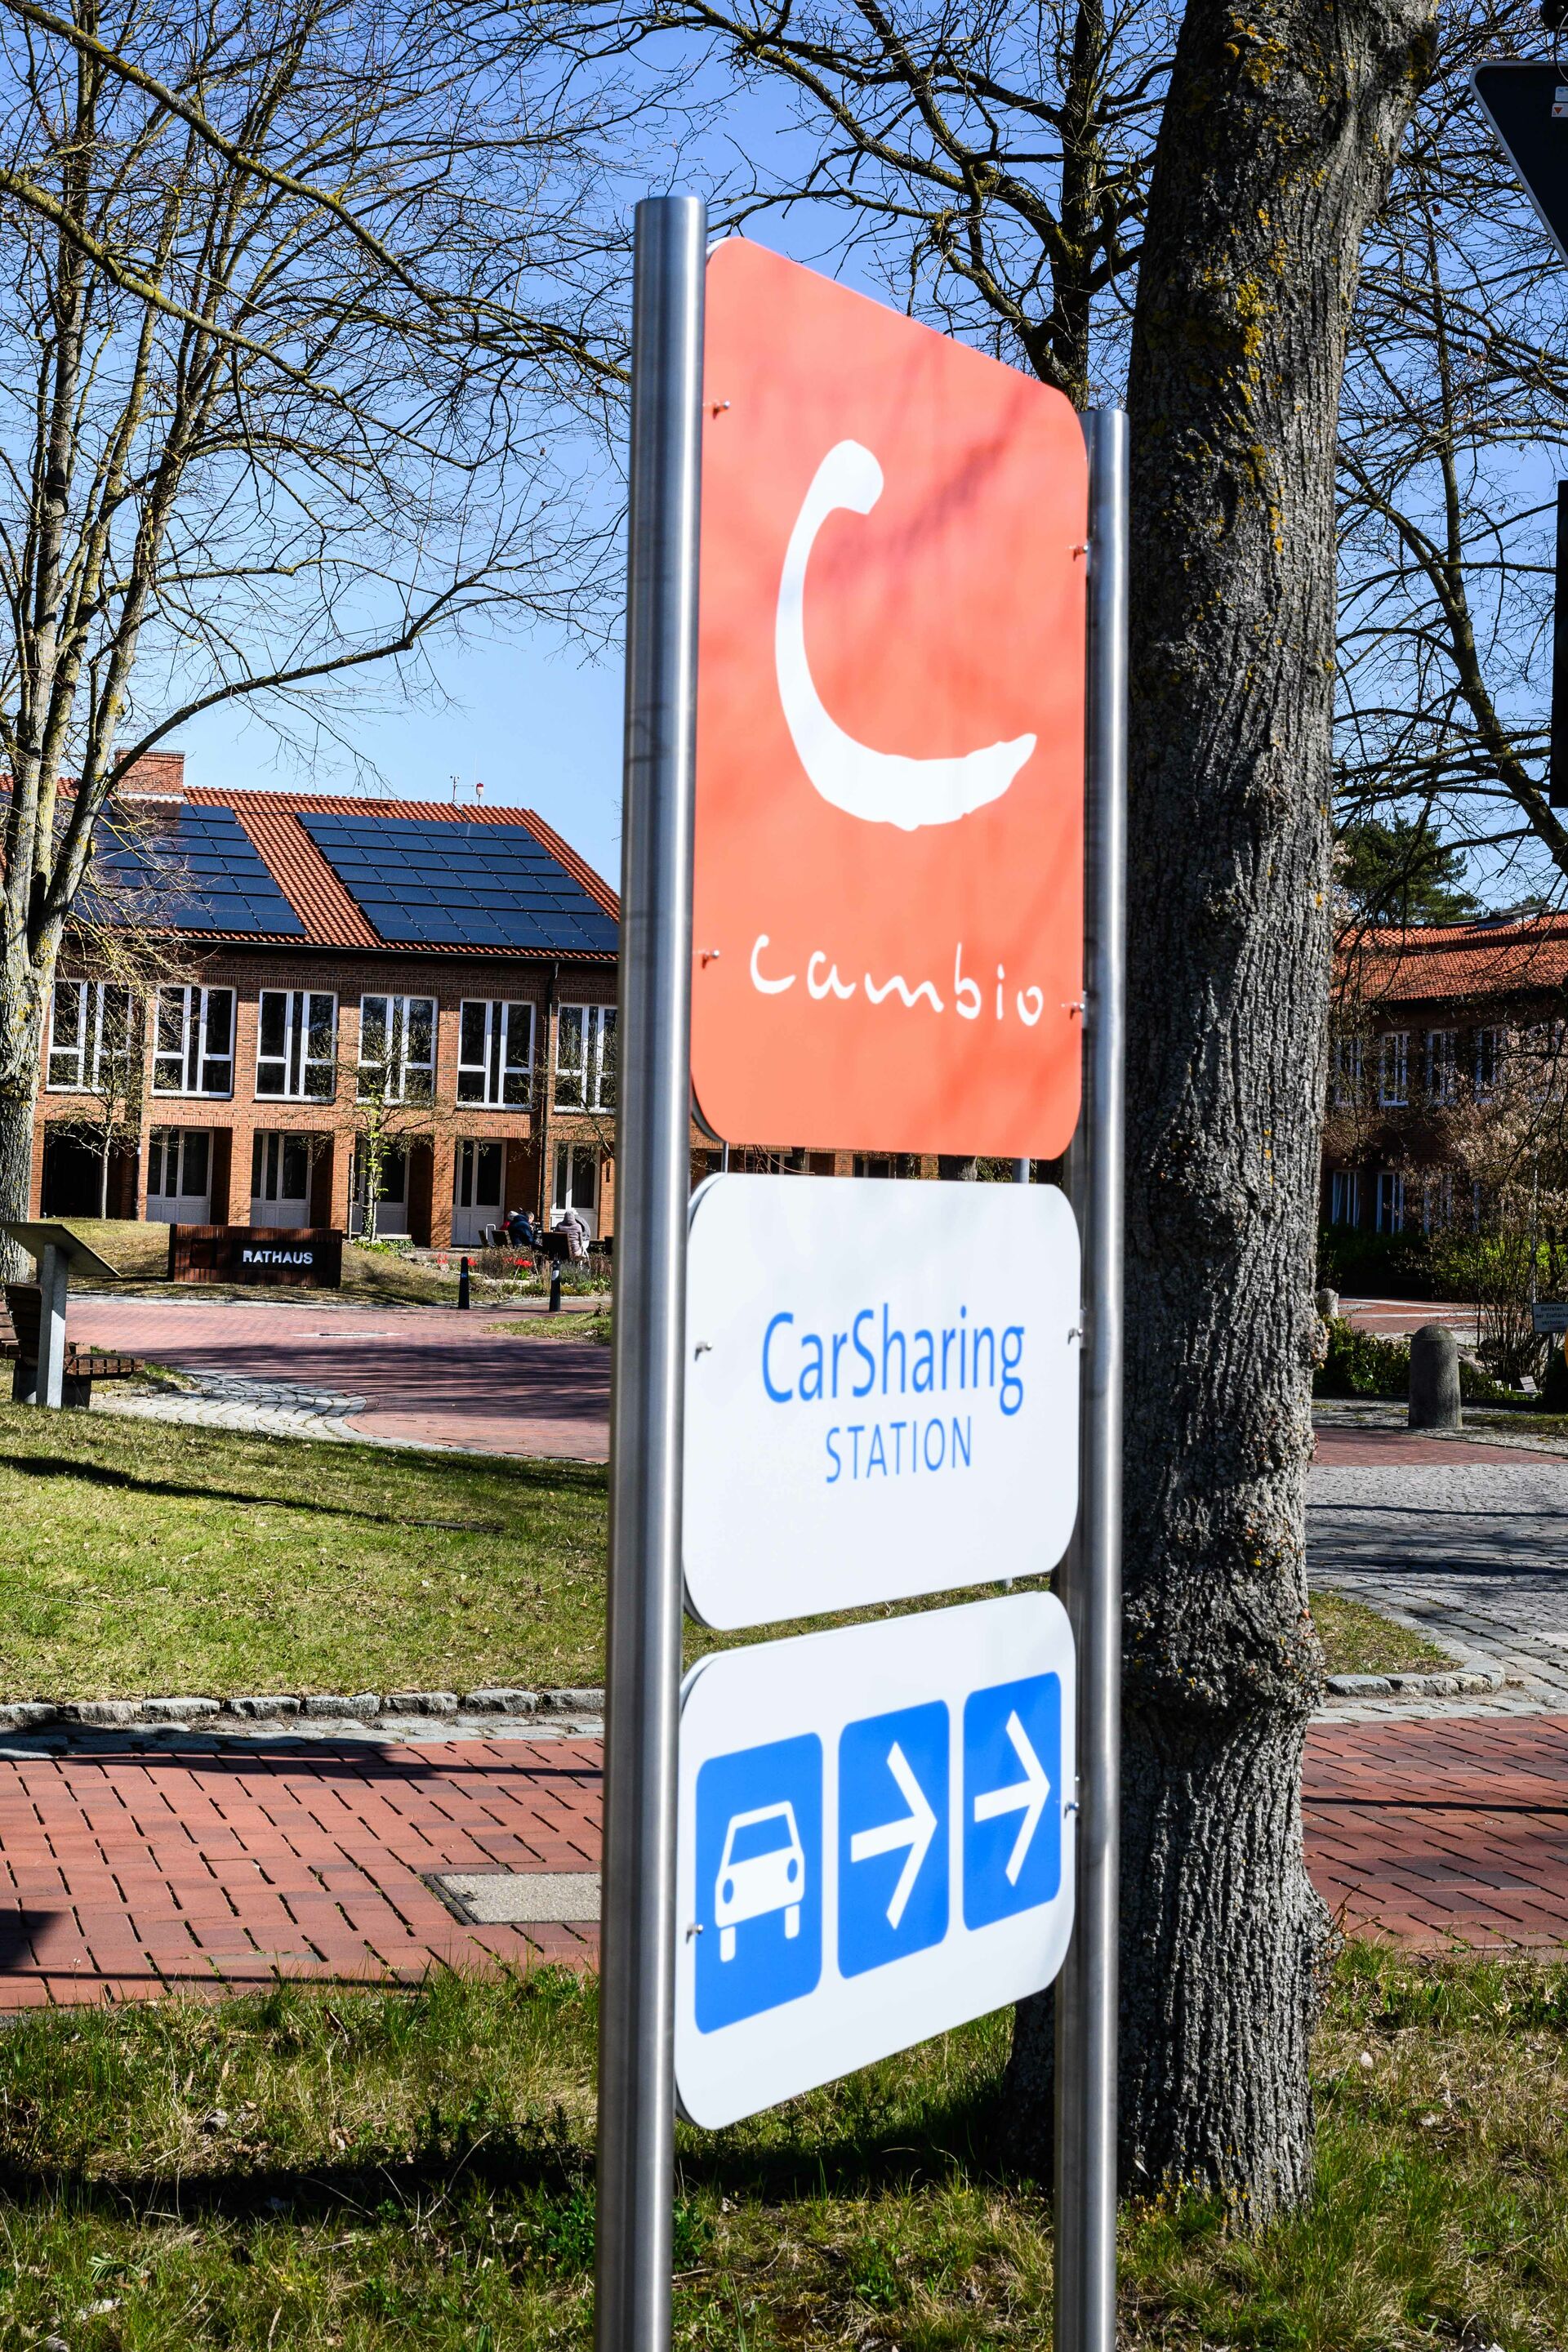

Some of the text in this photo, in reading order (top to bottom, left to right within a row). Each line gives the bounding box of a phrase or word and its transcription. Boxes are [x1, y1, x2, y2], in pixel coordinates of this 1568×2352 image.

[243, 1250, 312, 1264] RATHAUS
[762, 1302, 1025, 1416] CarSharing
[826, 1415, 971, 1483] STATION
